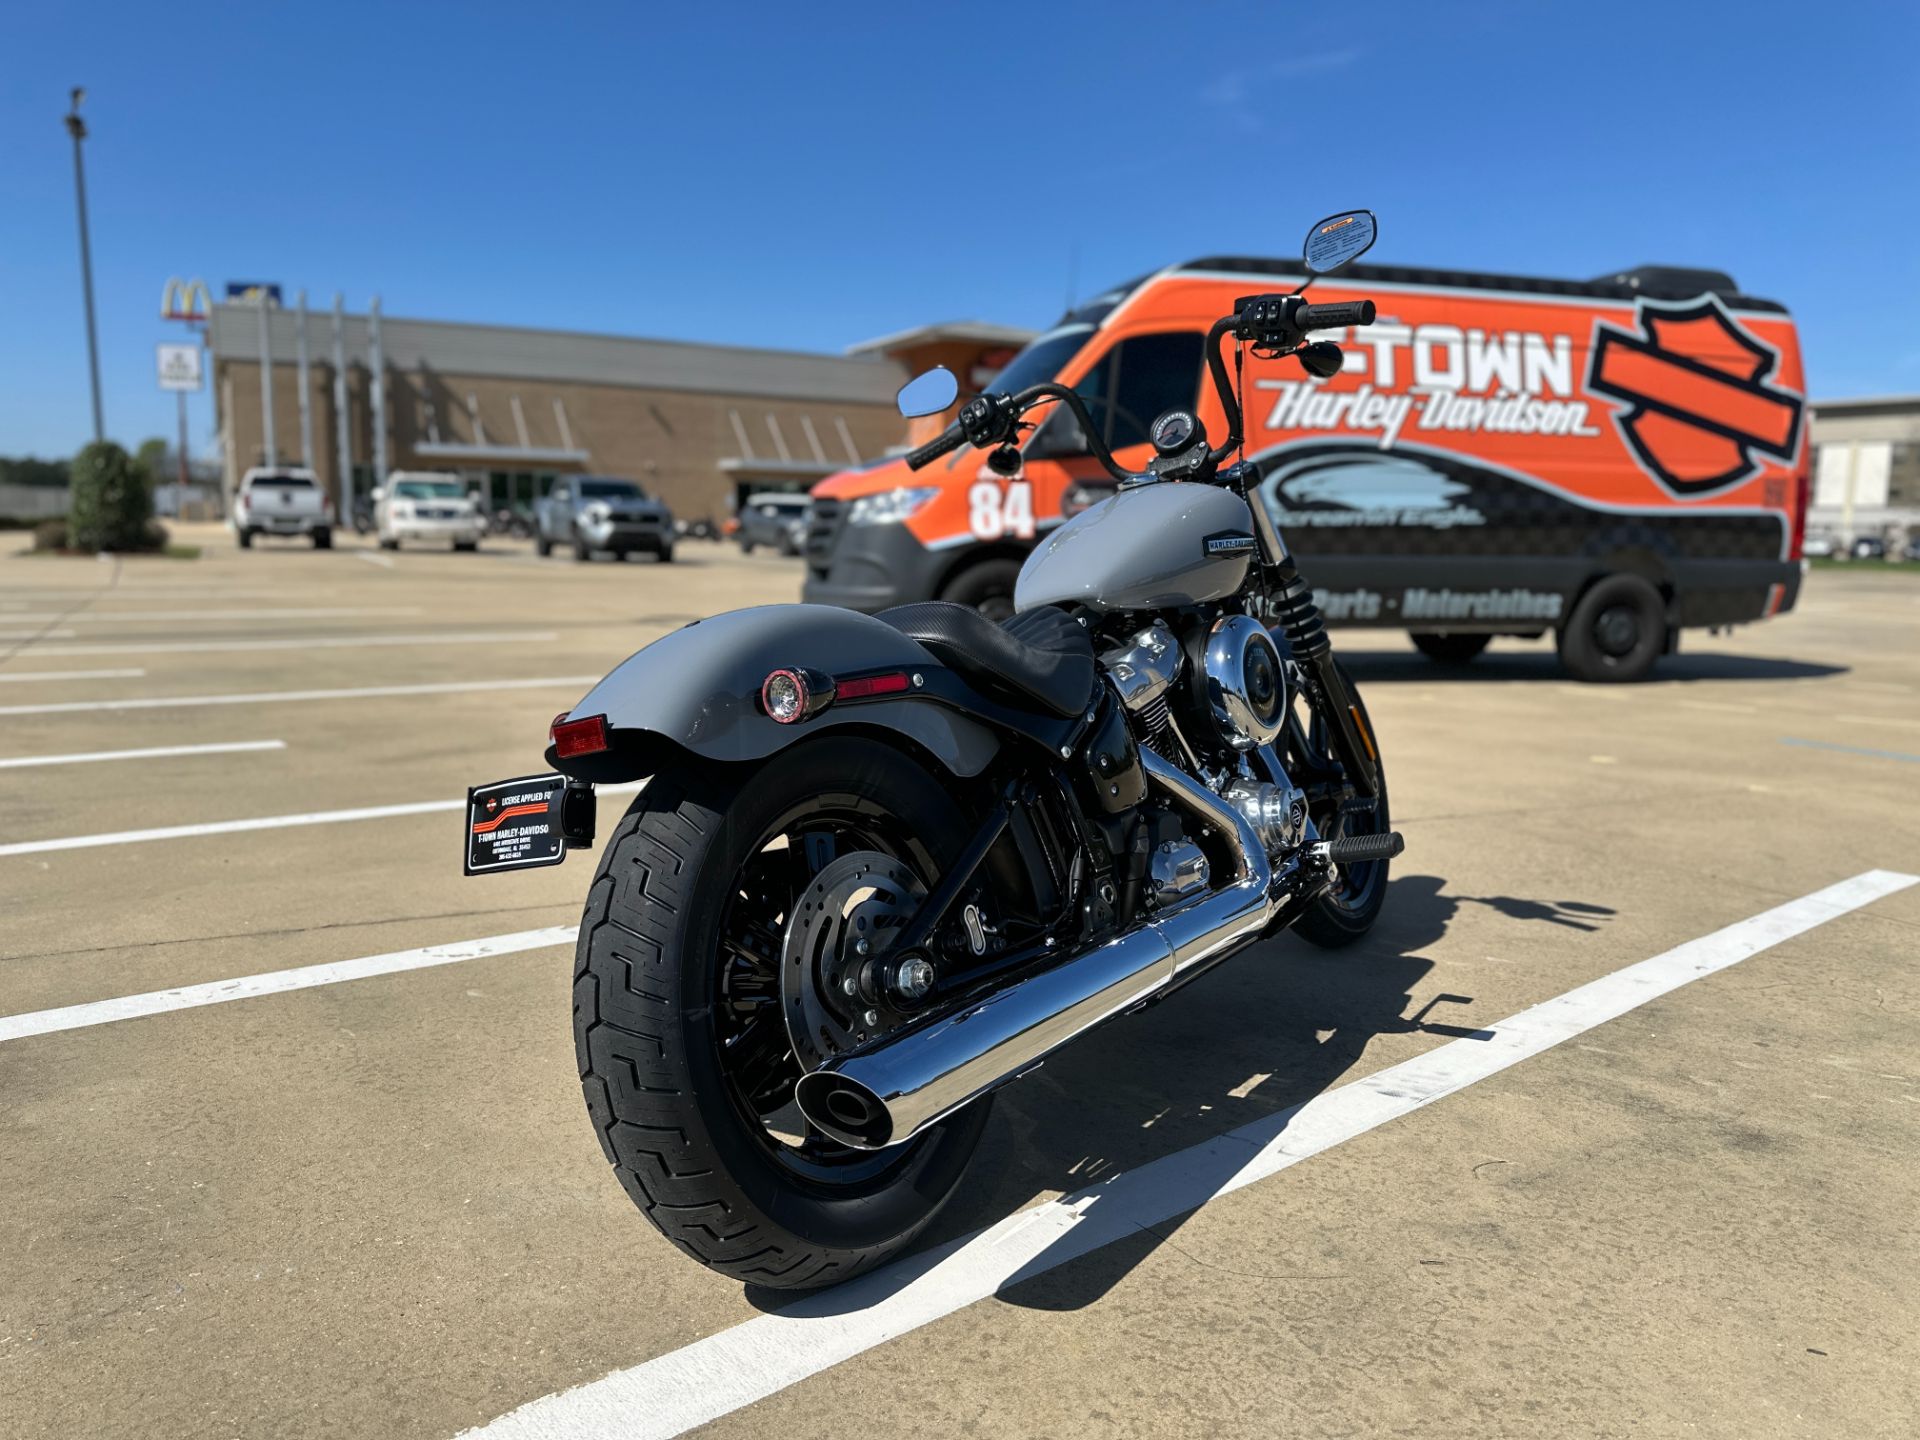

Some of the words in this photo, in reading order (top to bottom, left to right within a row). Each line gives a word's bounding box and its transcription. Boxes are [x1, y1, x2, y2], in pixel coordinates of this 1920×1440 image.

[969, 482, 1034, 539] 84
[502, 795, 520, 806] LICENSE
[521, 792, 543, 803] APPLIED
[497, 824, 549, 840] HARLEY-DAVIDSO
